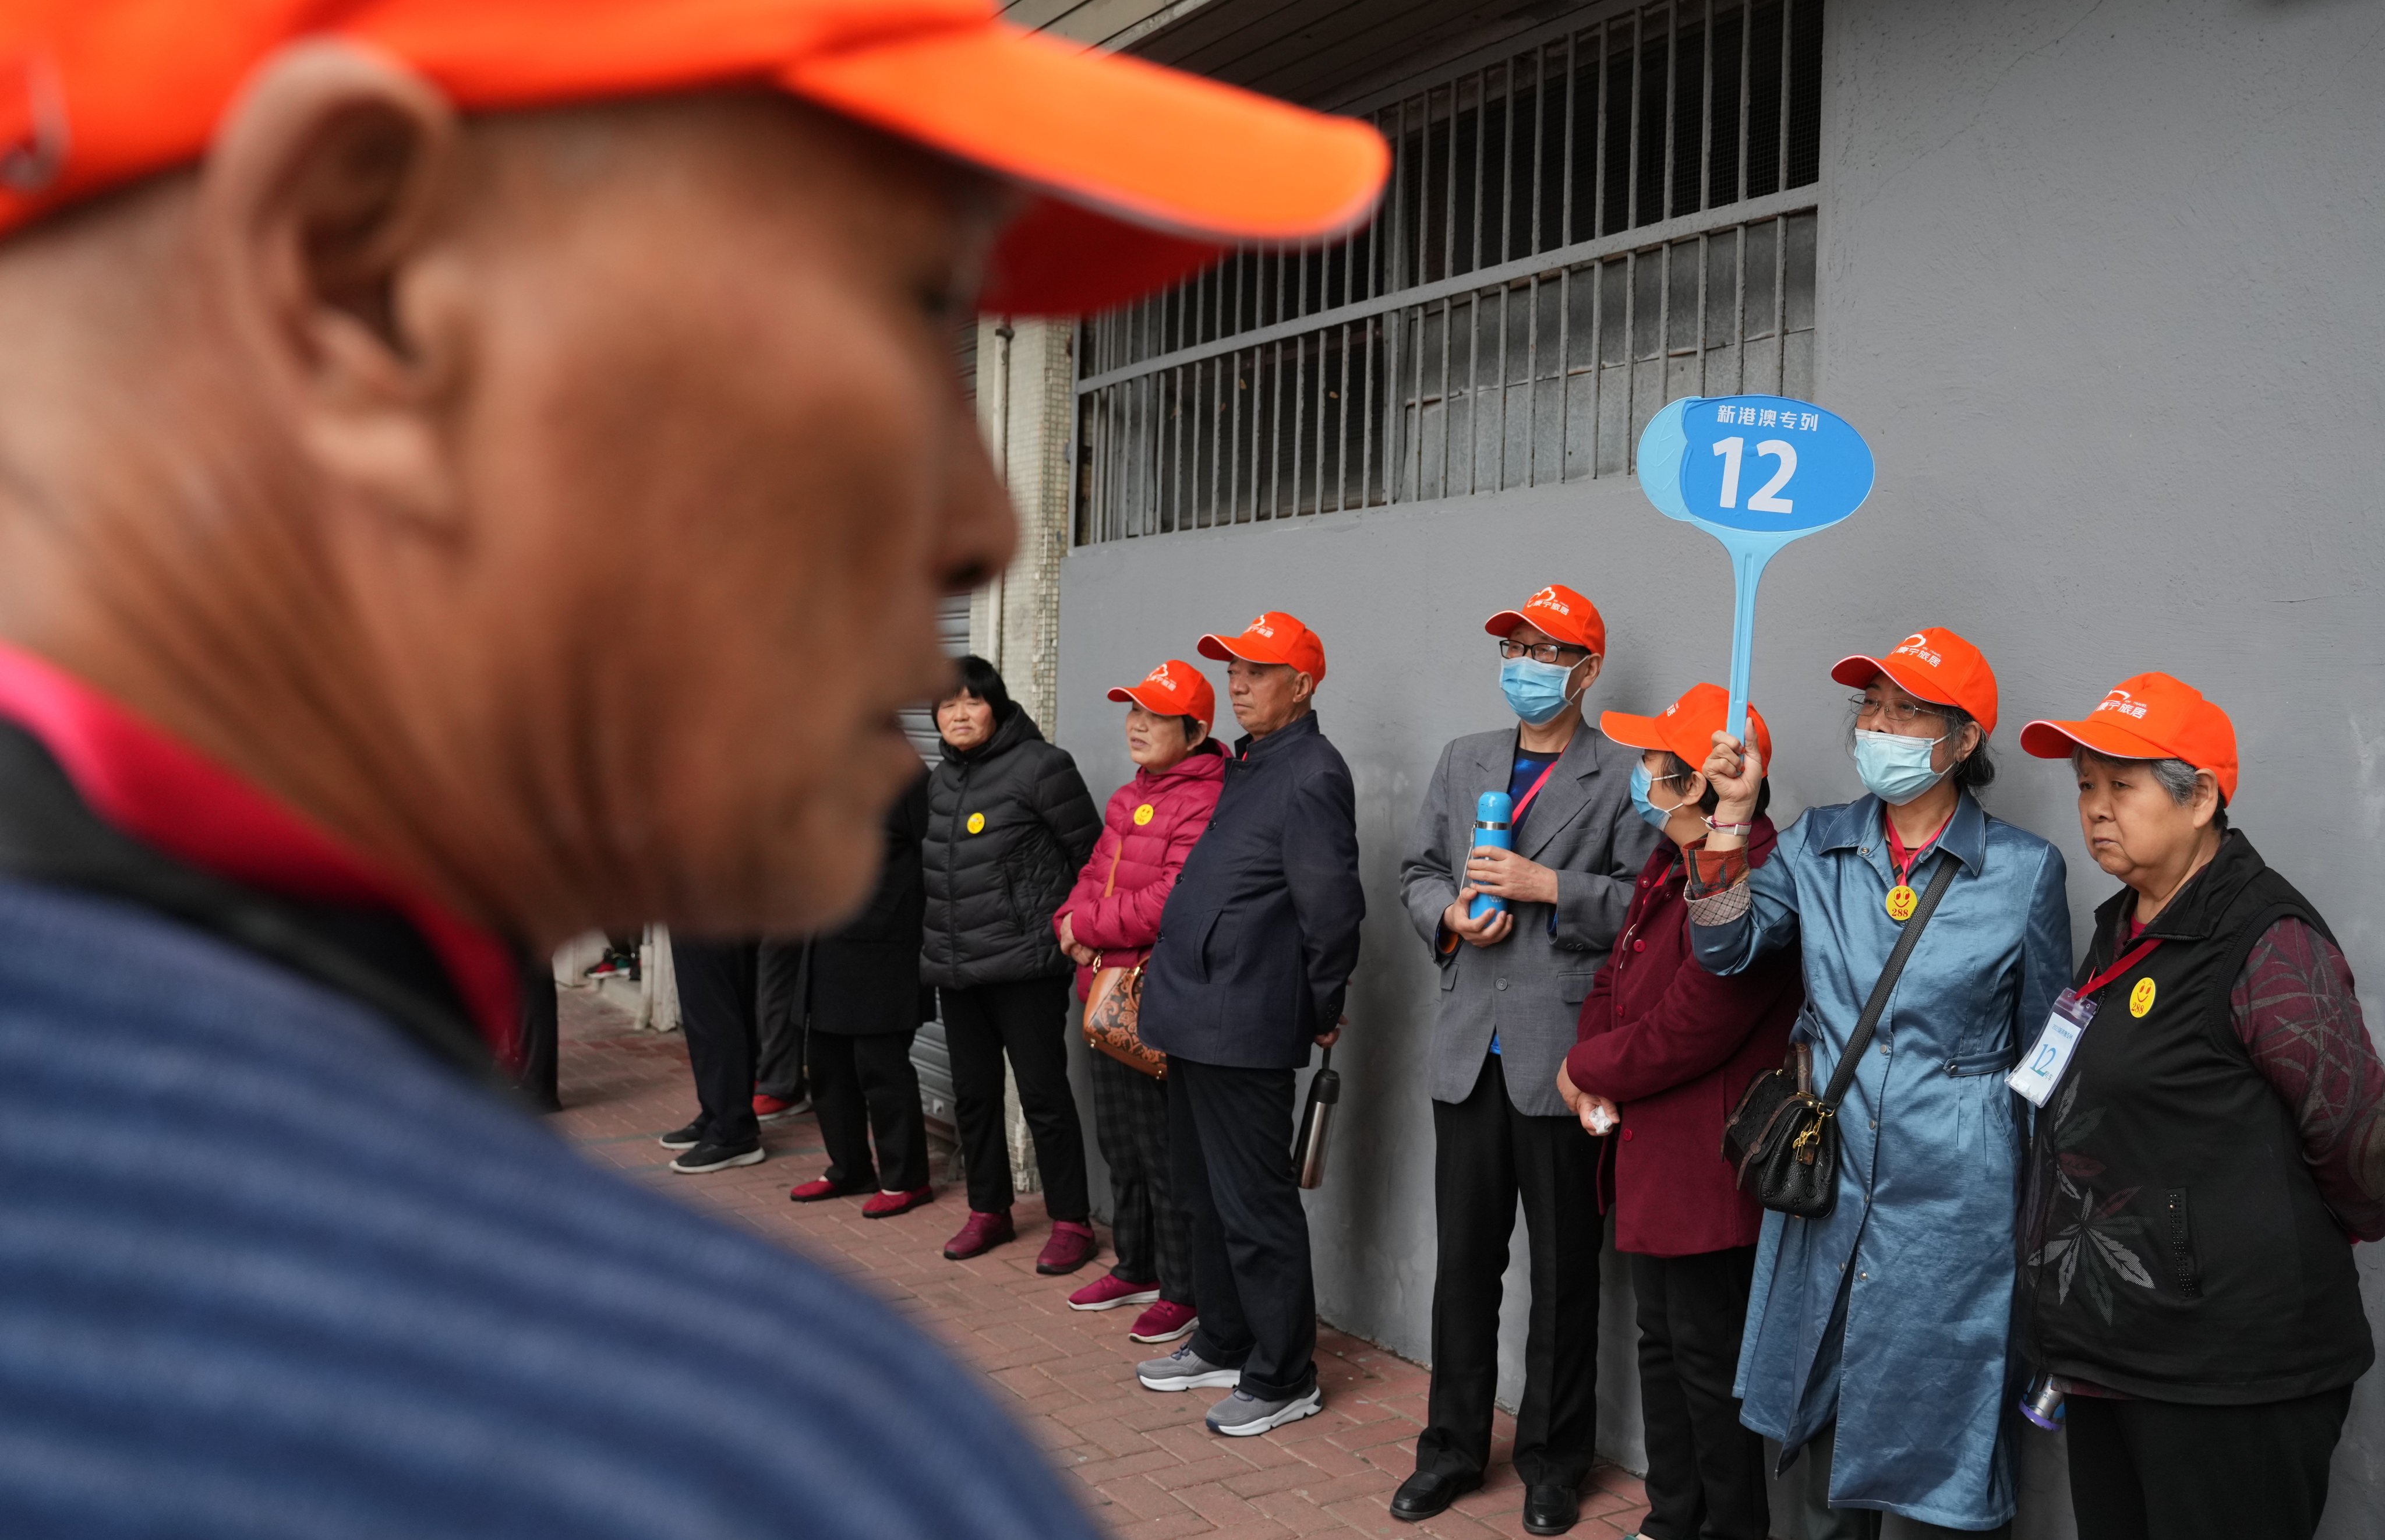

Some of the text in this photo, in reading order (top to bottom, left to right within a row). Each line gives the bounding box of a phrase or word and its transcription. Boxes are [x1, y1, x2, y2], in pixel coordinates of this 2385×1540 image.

[1717, 405, 1818, 432] 新港澳专列
[1712, 436, 1797, 514] 12
[1896, 646, 1941, 667] 康宁旅居
[1892, 909, 1909, 917] 288
[2131, 1002, 2144, 1015] 288
